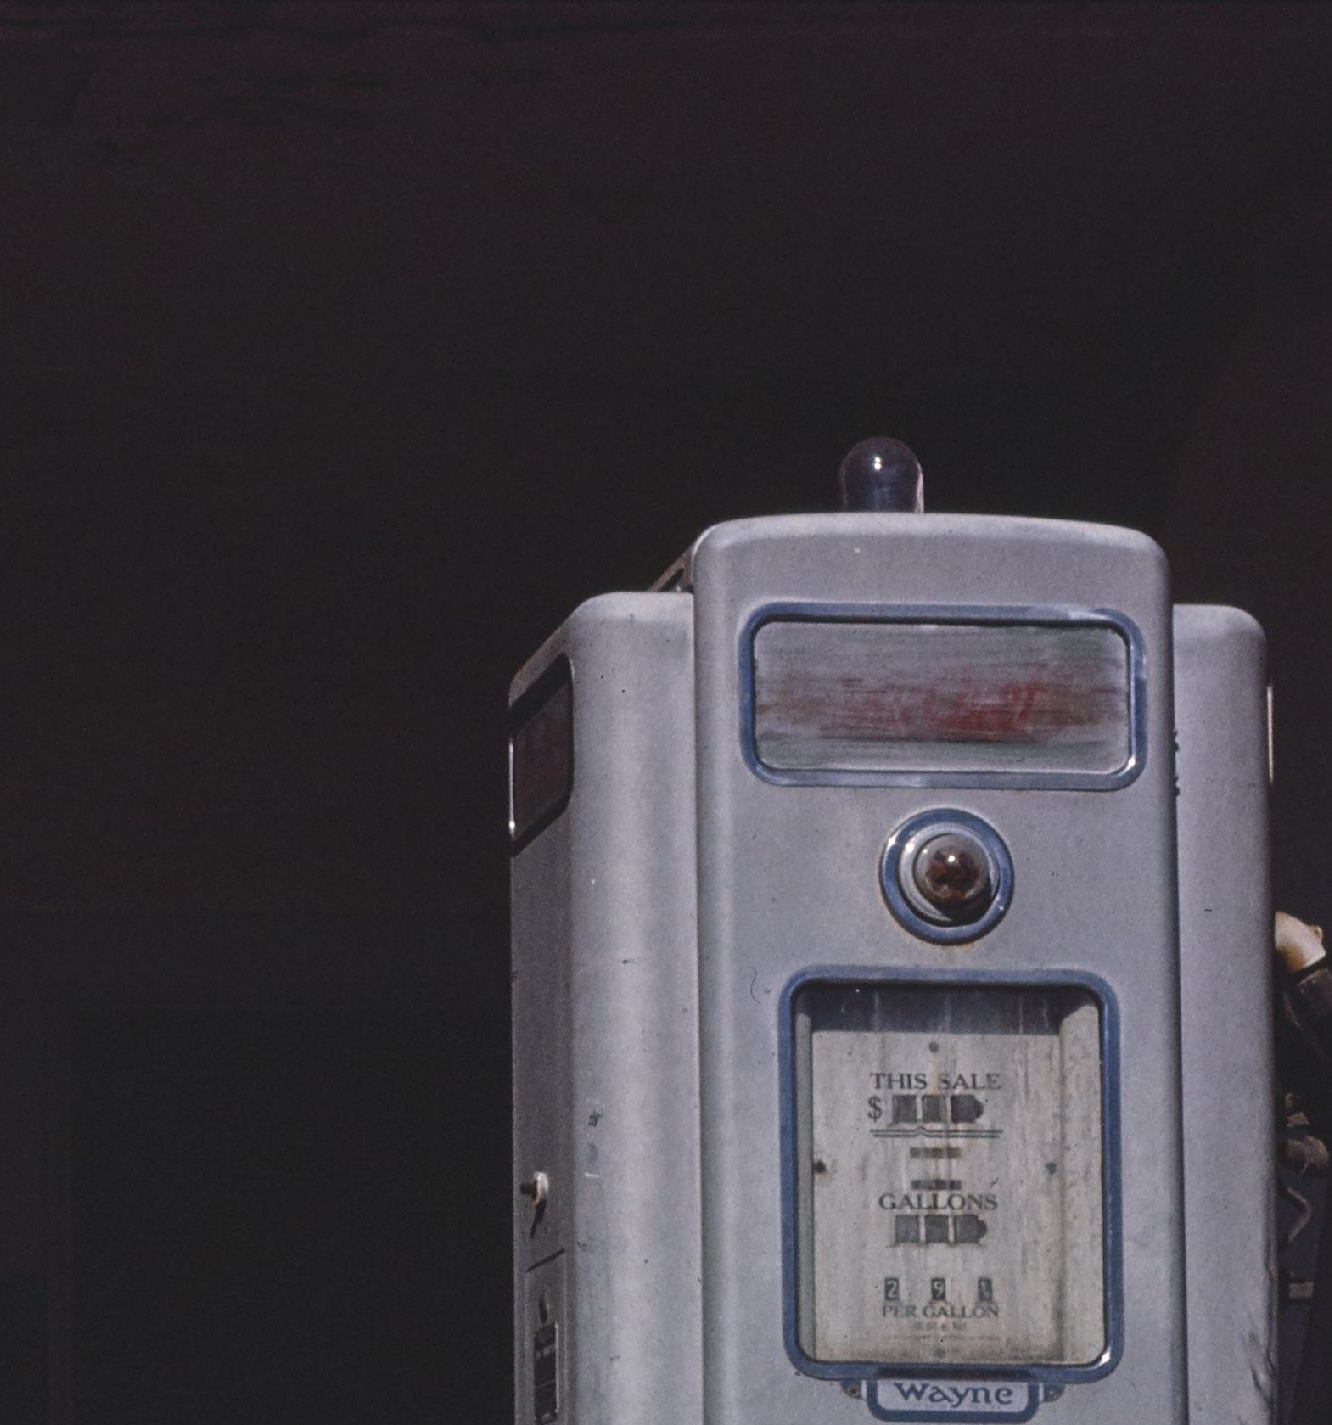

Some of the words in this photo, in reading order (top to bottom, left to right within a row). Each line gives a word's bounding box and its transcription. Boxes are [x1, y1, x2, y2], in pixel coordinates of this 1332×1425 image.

[871, 1073, 928, 1090] THIS
[938, 1073, 1002, 1090] SALE
[867, 1096, 883, 1120] $
[878, 1193, 998, 1210] GALLONS
[886, 1280, 898, 1299] 2
[882, 1305, 917, 1317] PER
[922, 1305, 1000, 1318] GALLON
[893, 1381, 1014, 1408] Wayne
